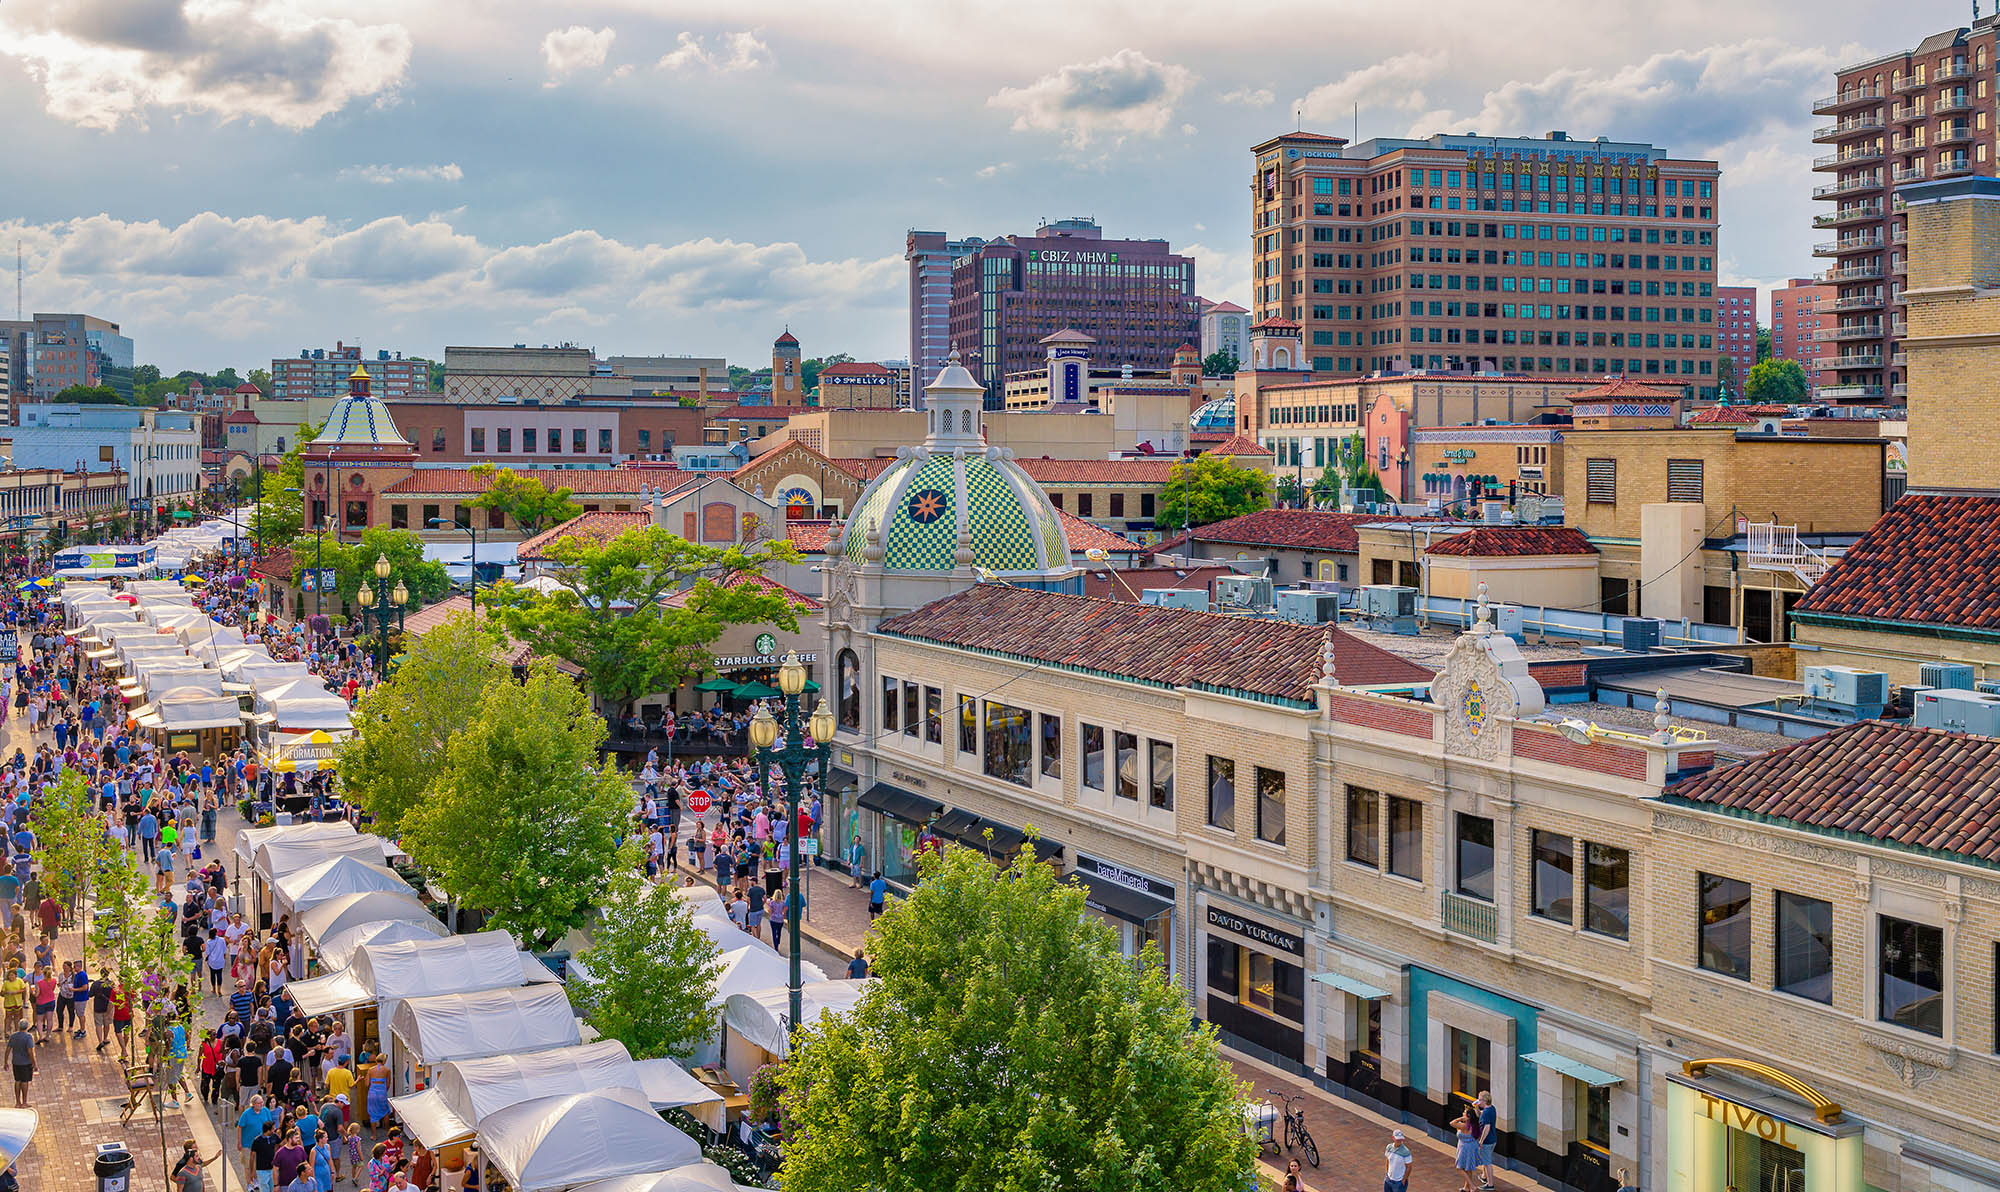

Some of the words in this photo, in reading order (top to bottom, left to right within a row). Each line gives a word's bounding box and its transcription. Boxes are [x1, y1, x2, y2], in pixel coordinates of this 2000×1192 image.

[1040, 250, 1070, 262] CBIZ
[1075, 252, 1107, 263] MHM
[714, 655, 776, 666] STARBUCKS
[780, 653, 817, 663] CFFEE
[281, 747, 333, 759] INFORMATION
[690, 797, 710, 806] STOP
[1096, 862, 1149, 891] bareMinerals
[1209, 911, 1242, 930] DAVID
[1245, 924, 1296, 949] YURMAN
[1700, 1093, 1797, 1150] TIVOL
[1582, 1153, 1600, 1166] TIVOL
